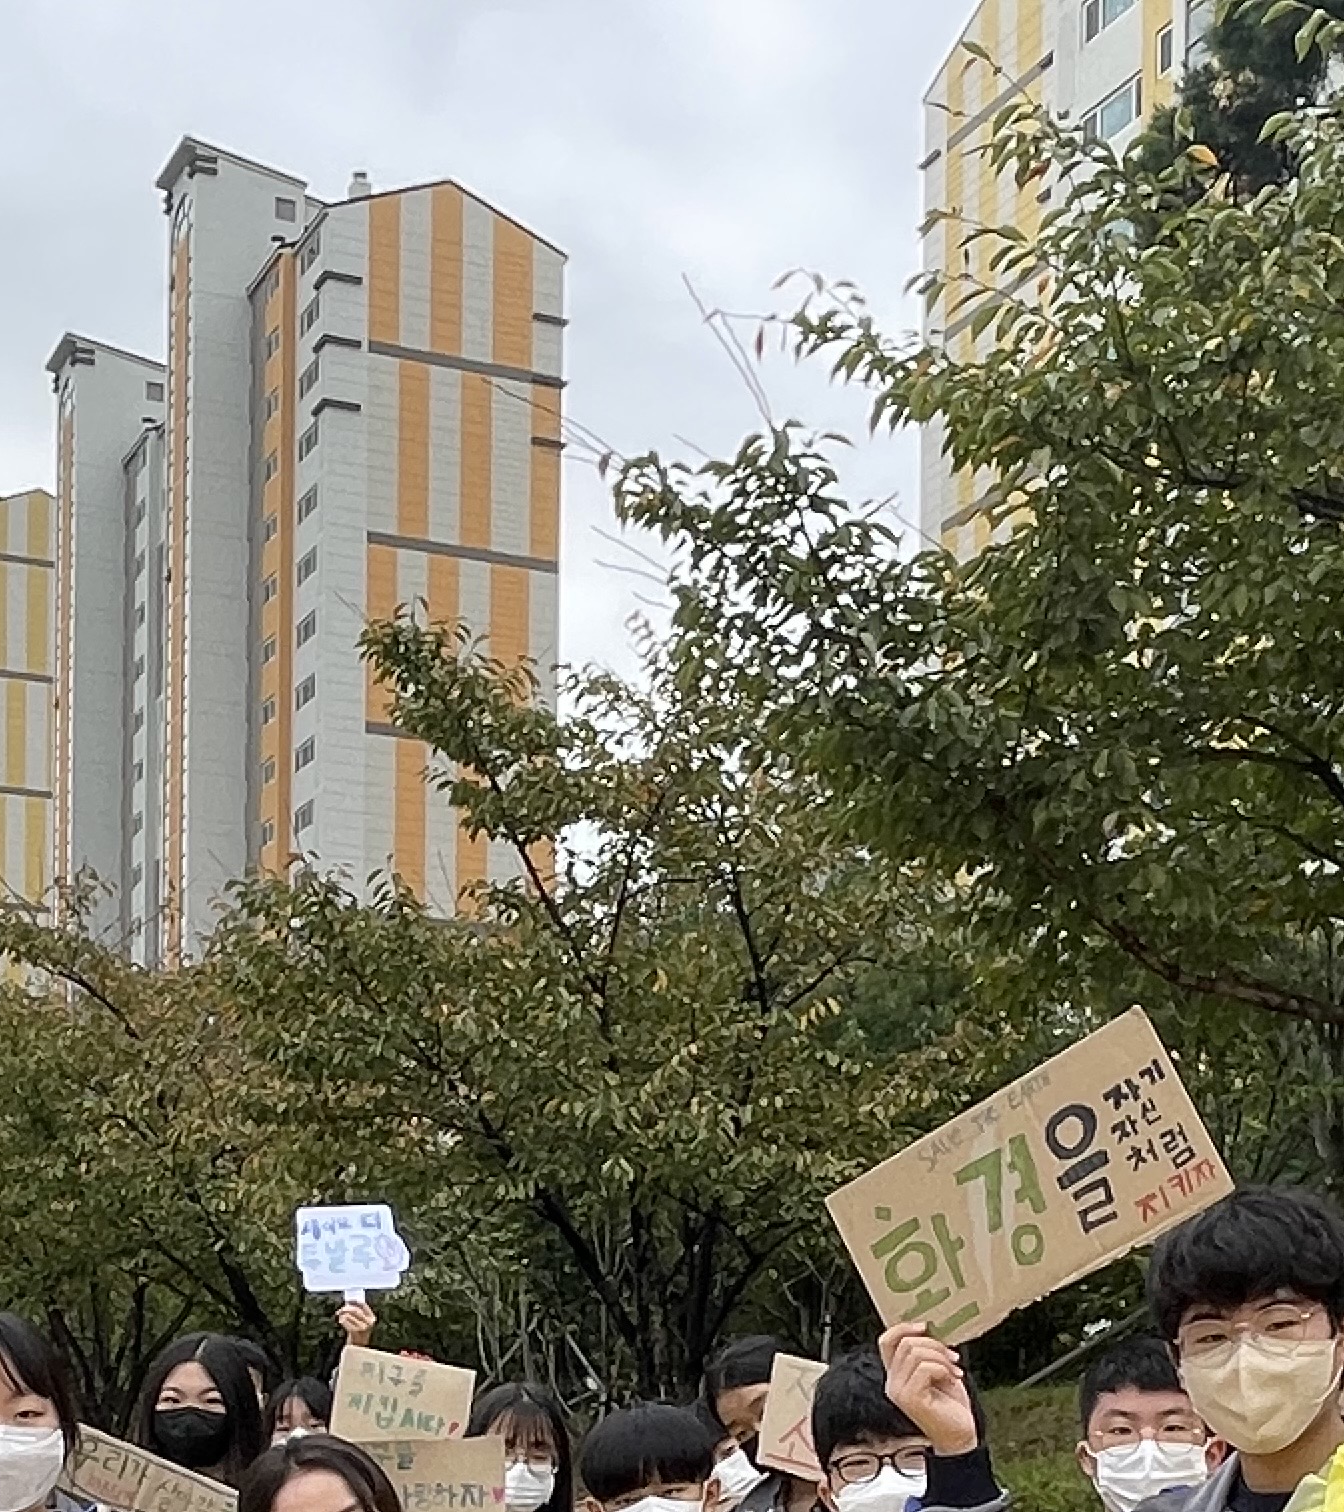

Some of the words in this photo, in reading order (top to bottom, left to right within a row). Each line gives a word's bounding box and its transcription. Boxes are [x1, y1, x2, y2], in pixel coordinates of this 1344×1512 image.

[1102, 1058, 1166, 1111] 자기
[1110, 1097, 1162, 1145] 자신
[1125, 1121, 1197, 1171] 처럼
[1134, 1158, 1216, 1223] 지키자
[870, 1103, 1119, 1338] 환경을
